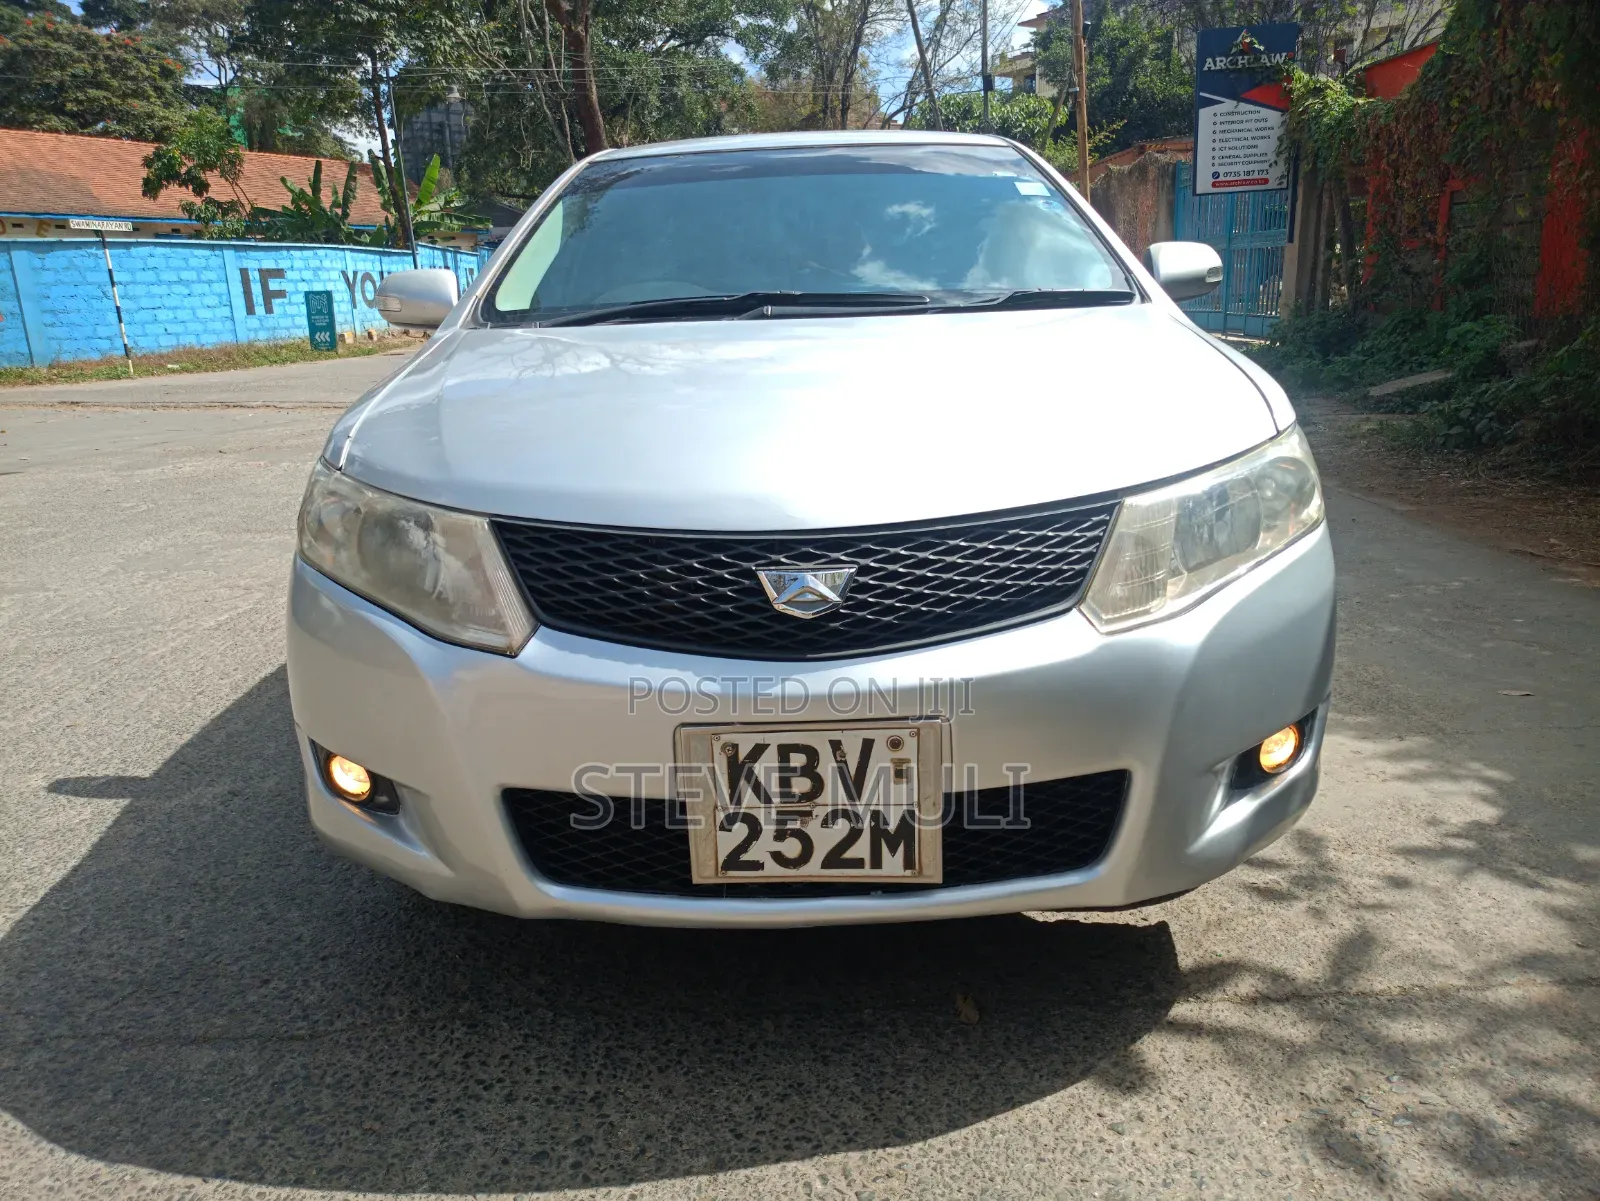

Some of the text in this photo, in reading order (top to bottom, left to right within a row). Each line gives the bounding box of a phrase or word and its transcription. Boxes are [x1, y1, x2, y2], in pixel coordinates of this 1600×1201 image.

[239, 268, 392, 315] IF YO
[726, 737, 876, 806] KBV
[718, 807, 916, 872] 252M
